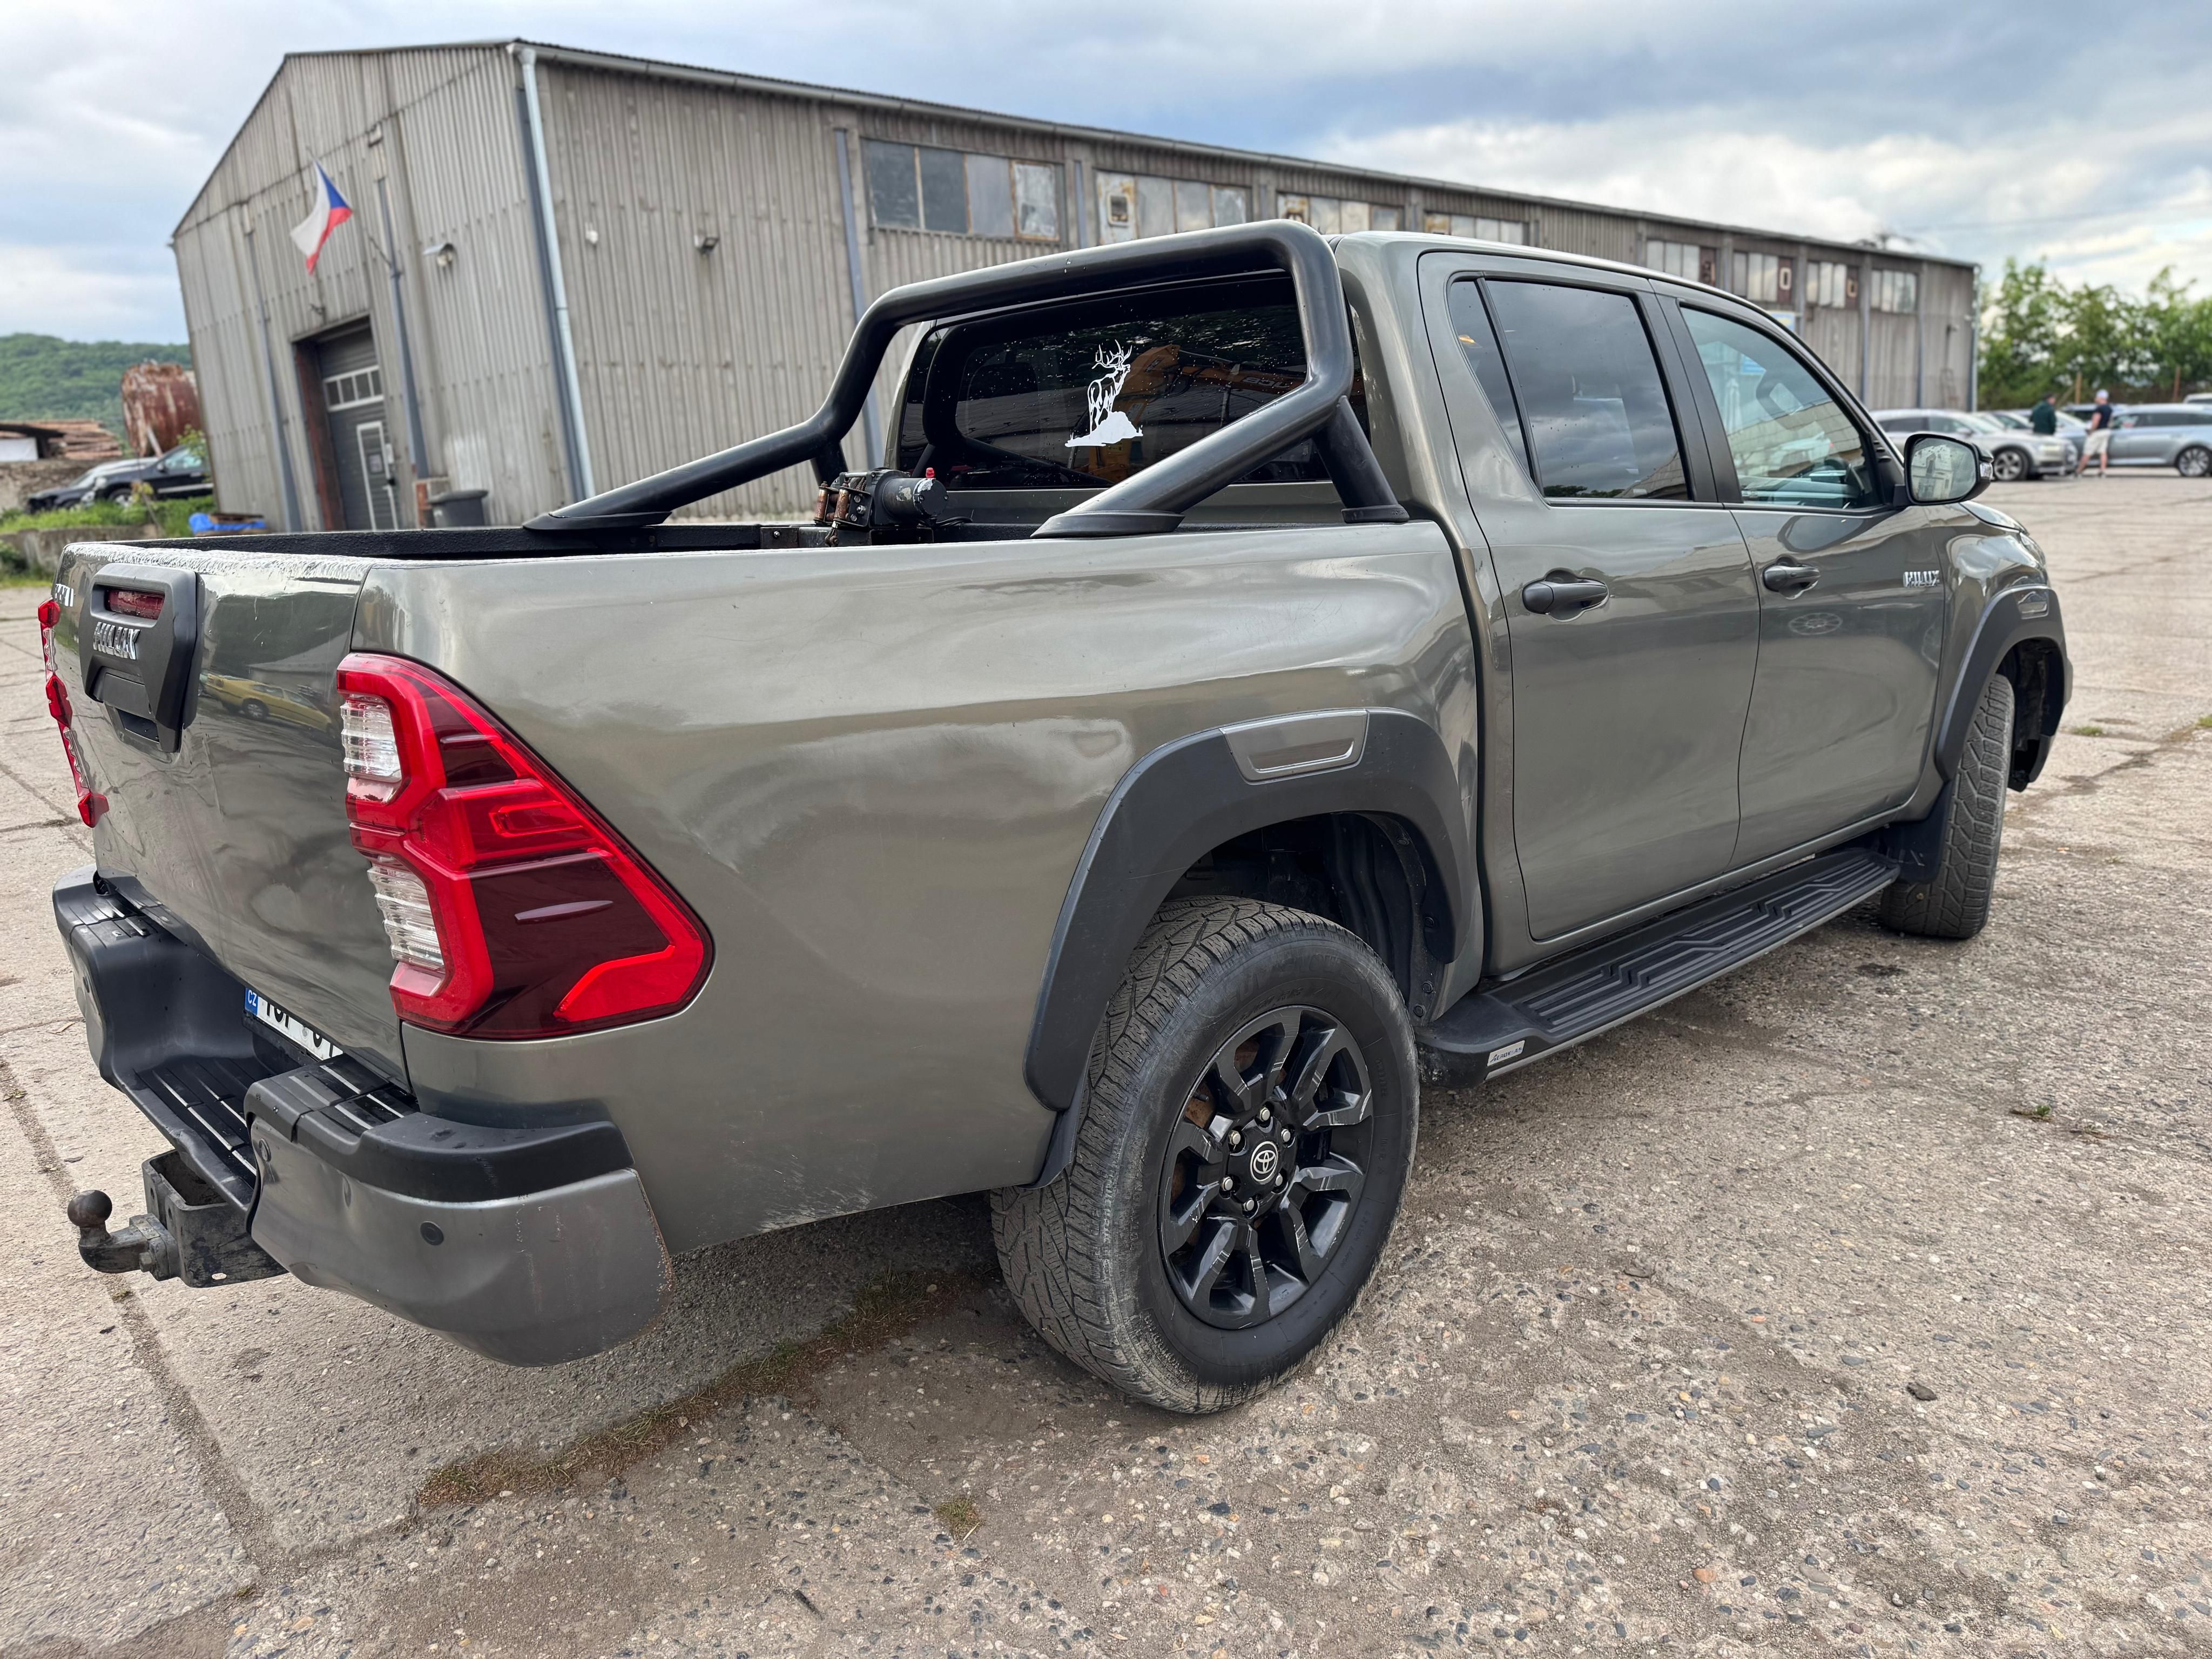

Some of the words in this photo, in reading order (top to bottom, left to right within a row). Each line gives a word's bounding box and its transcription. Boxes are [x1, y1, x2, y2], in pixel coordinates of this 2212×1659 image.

[1903, 570, 1940, 588] HILUX
[93, 622, 140, 660] HILUX
[247, 989, 257, 1007] CZ
